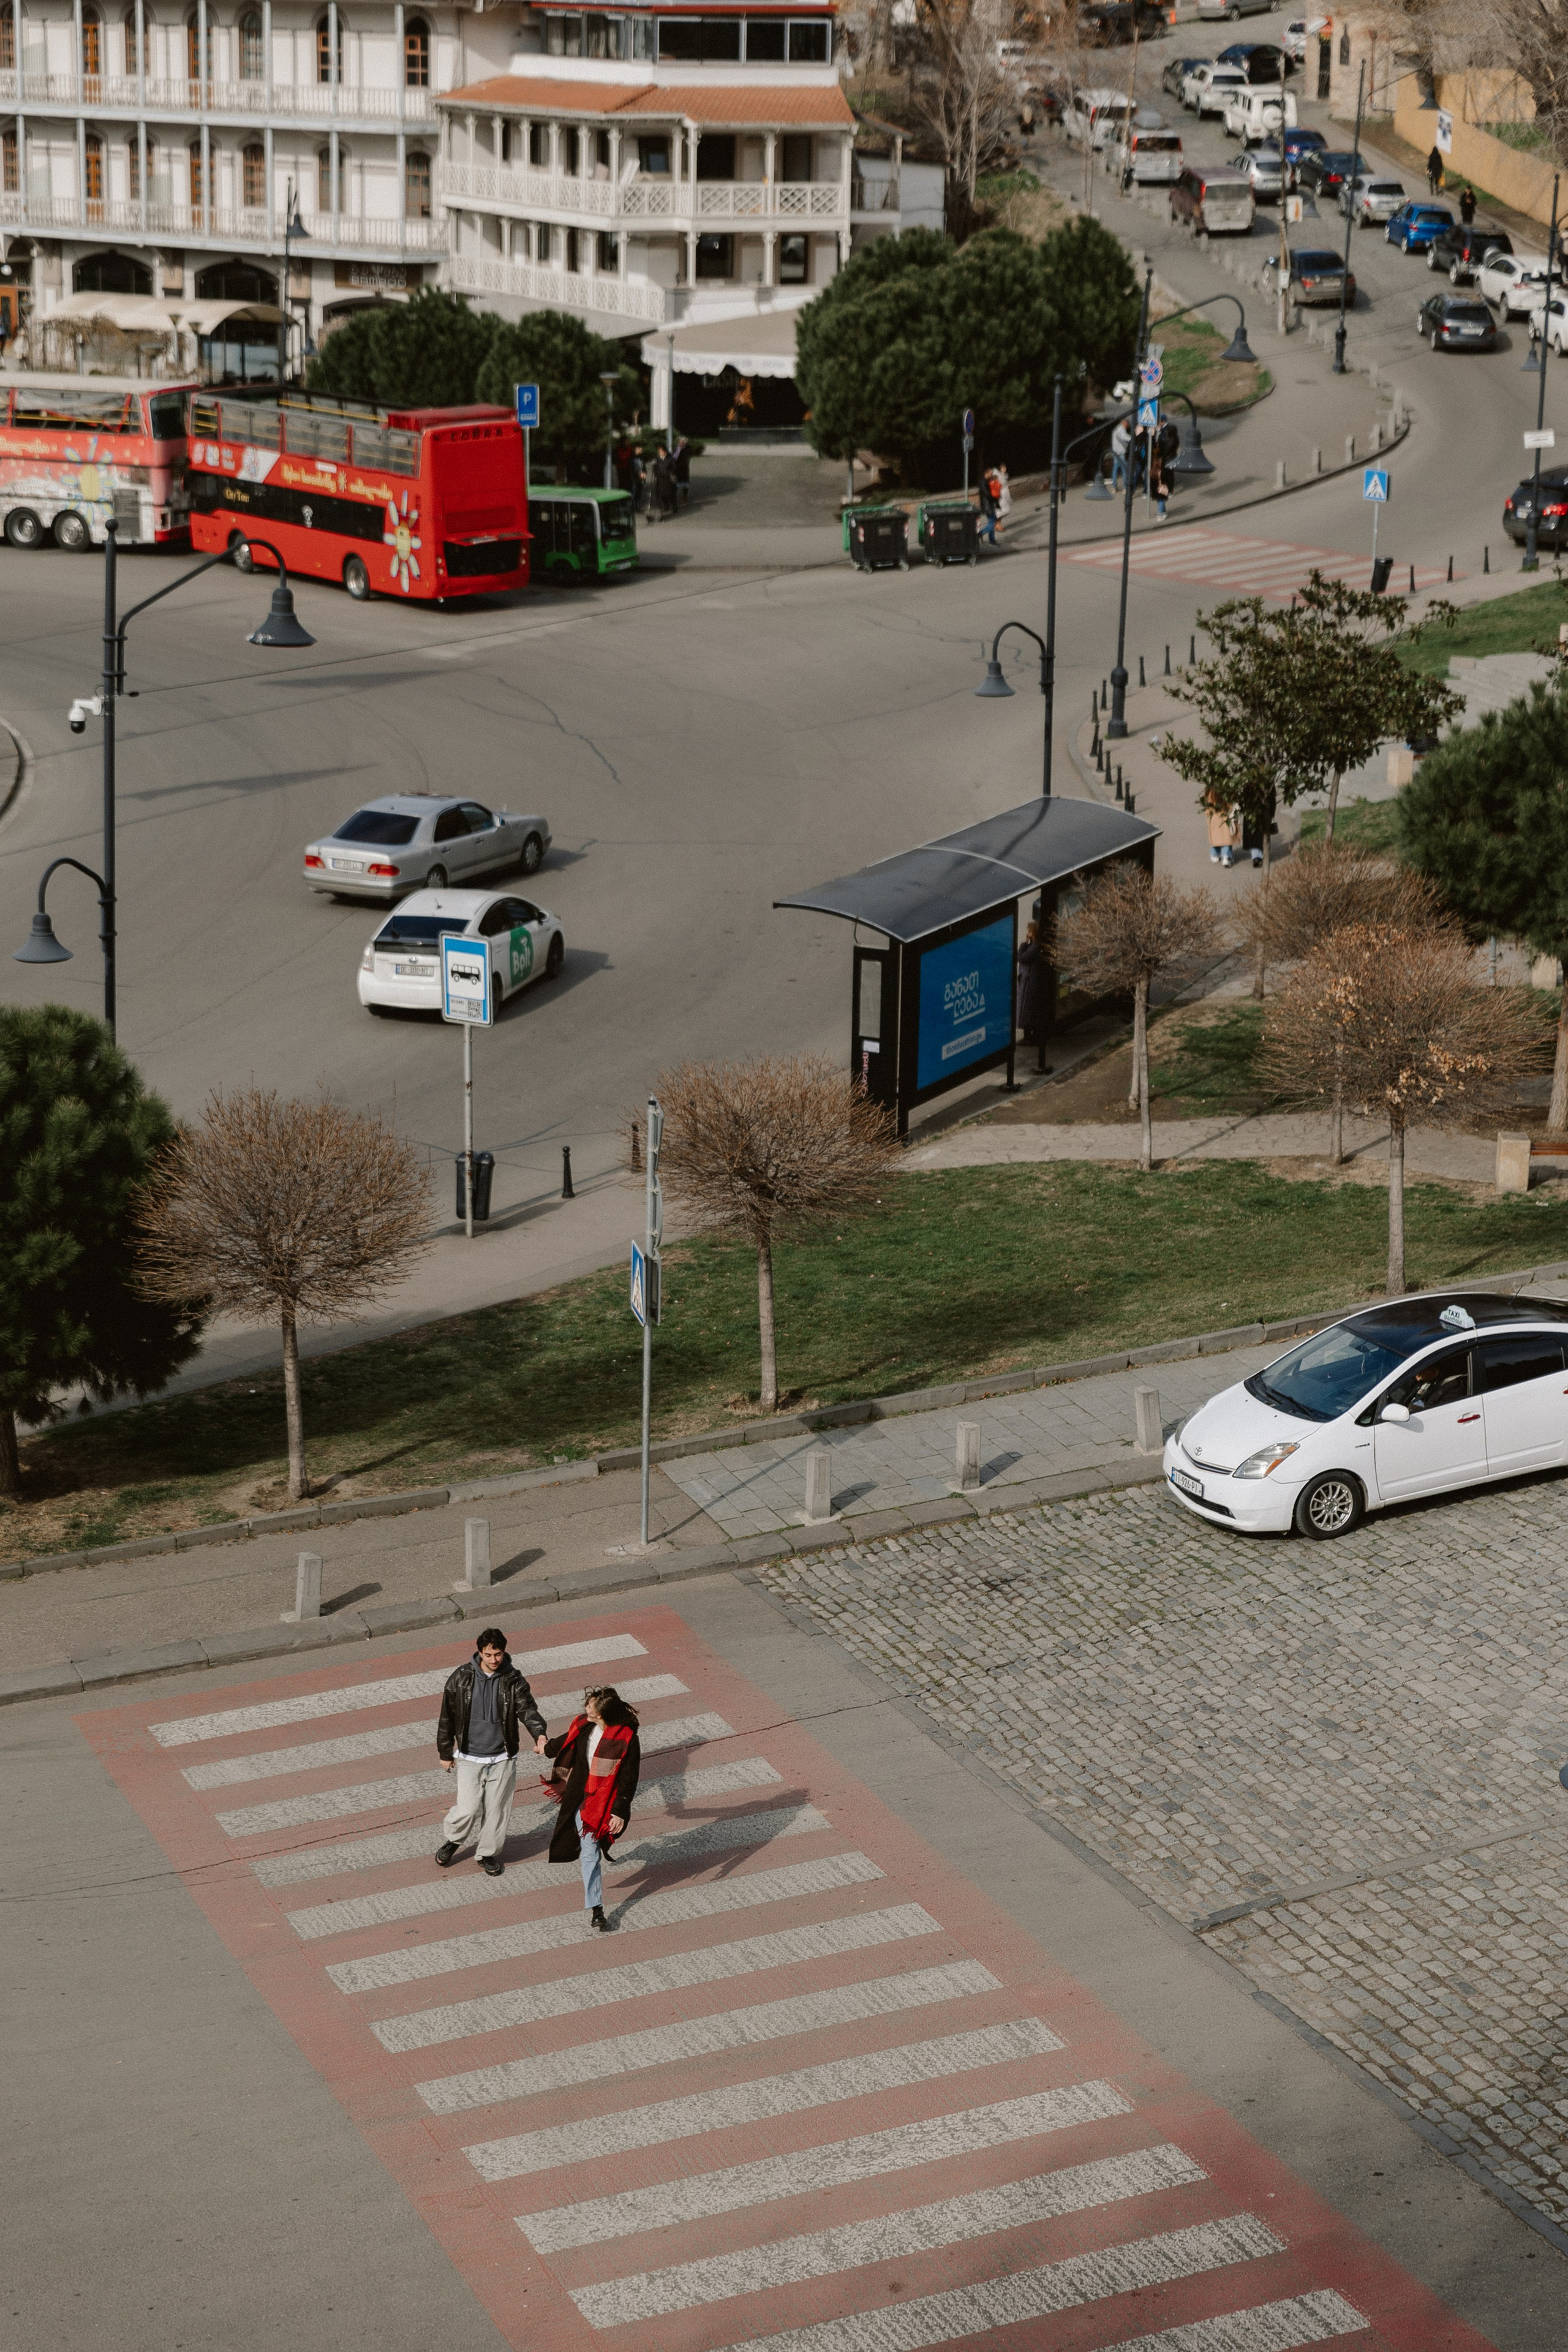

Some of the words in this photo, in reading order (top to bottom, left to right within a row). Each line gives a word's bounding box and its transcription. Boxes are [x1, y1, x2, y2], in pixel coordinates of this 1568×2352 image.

[524, 391, 532, 405] P
[512, 946, 531, 976] Bolt
[1448, 1309, 1460, 1319] TAXI
